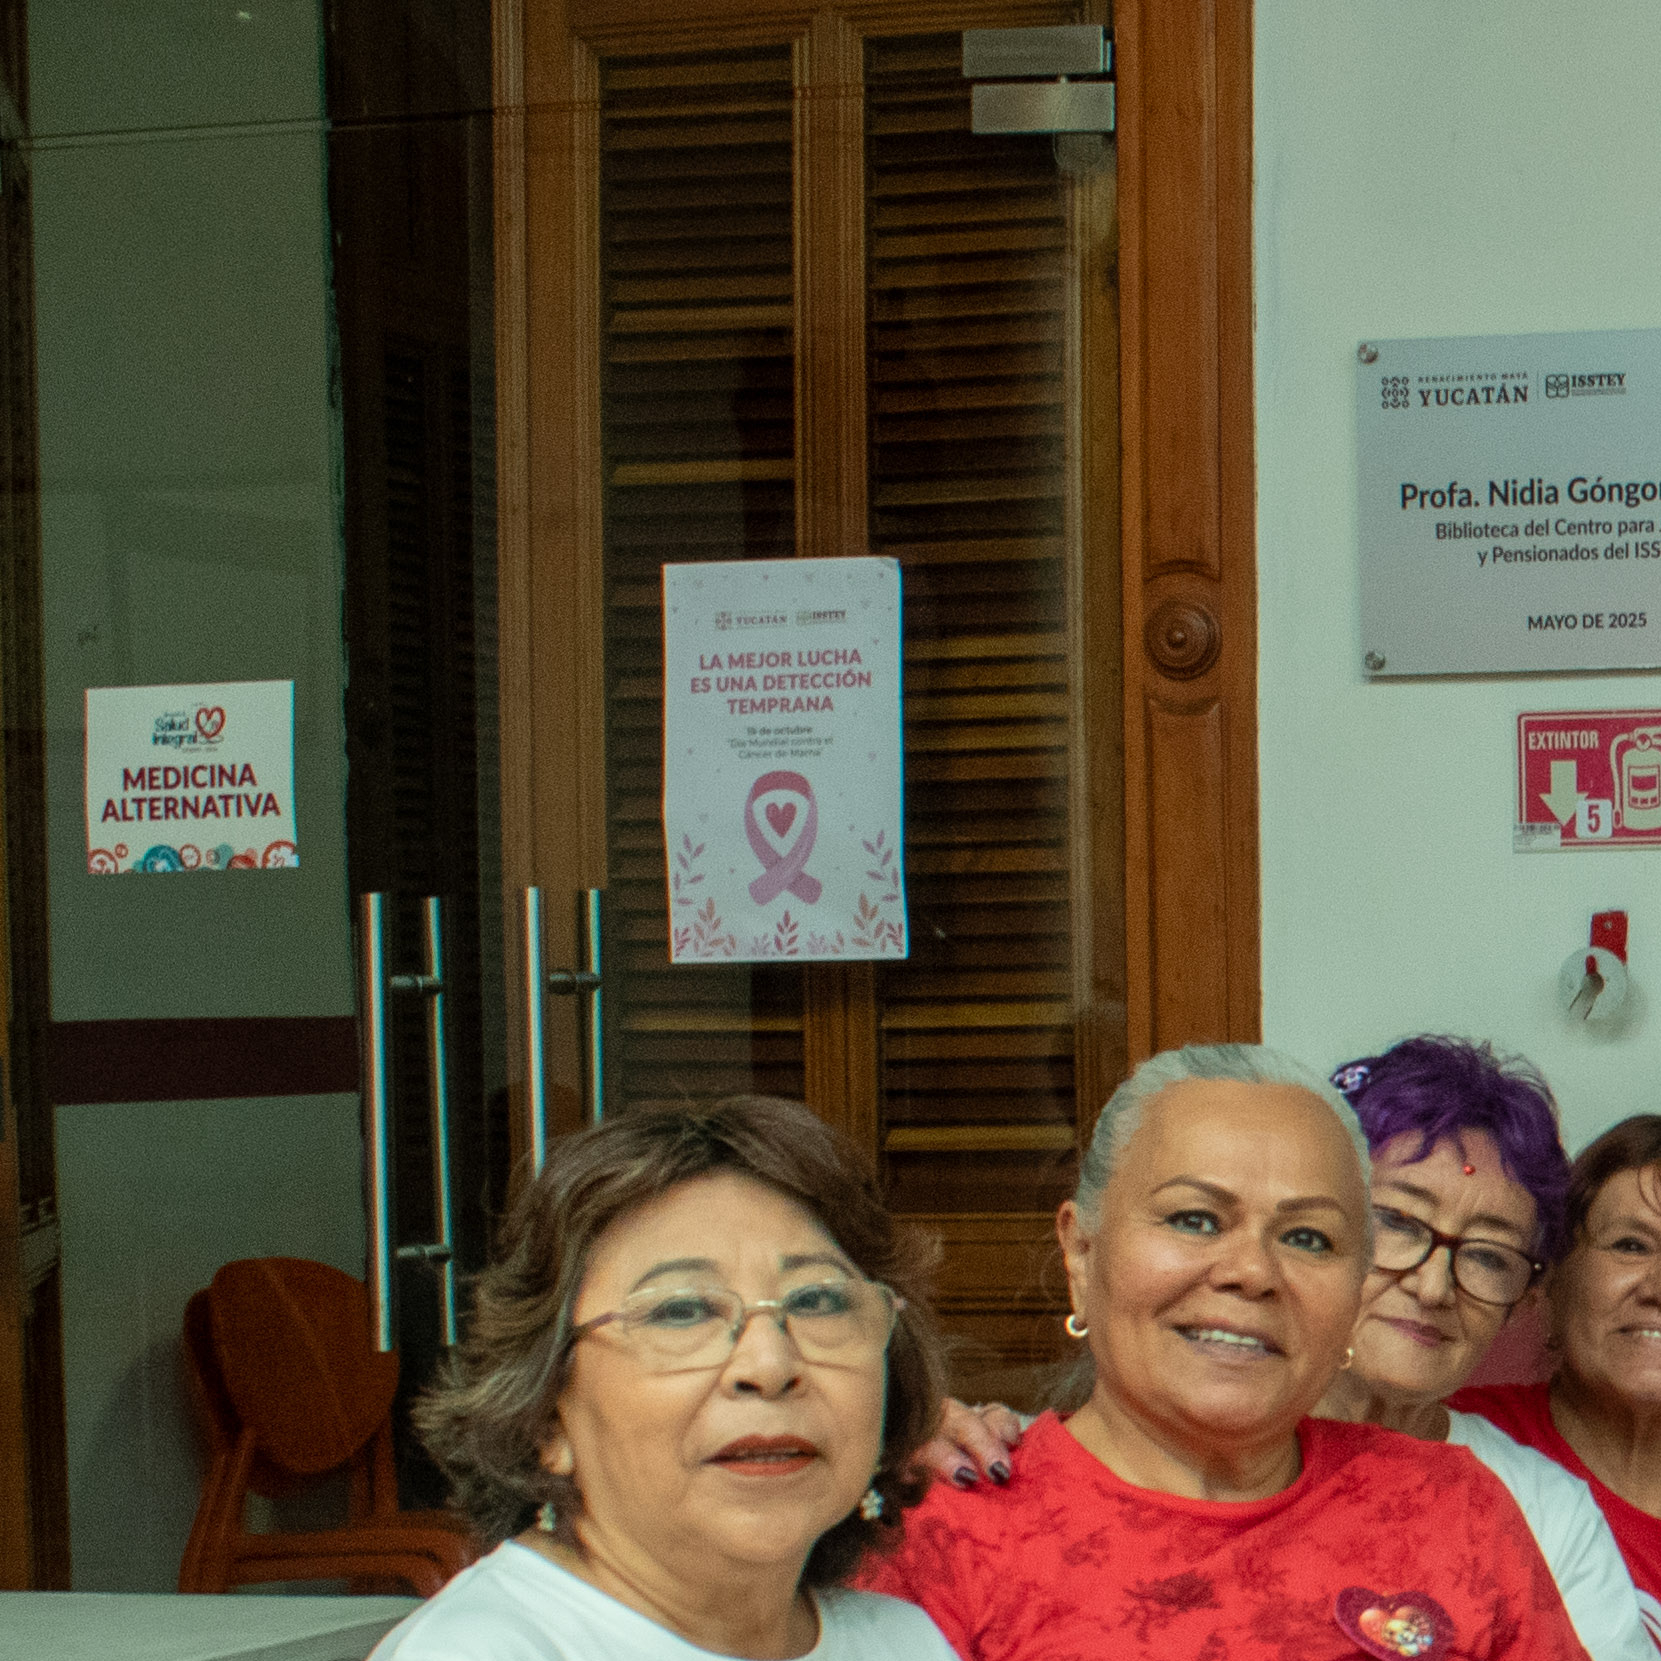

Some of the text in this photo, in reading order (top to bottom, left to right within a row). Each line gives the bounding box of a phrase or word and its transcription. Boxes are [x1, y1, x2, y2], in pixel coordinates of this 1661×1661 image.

[1571, 373, 1627, 388] ISSTEY
[1418, 382, 1529, 407] YUCATÁN
[1400, 481, 1480, 510] Profa.
[1488, 477, 1560, 507] Nidia
[1435, 518, 1520, 540] Biblioteca
[1524, 517, 1550, 538] del
[1554, 516, 1613, 537] Centro
[1617, 519, 1656, 539] para
[1477, 550, 1488, 567] y
[1492, 543, 1600, 564] Pensionados
[1603, 541, 1630, 561] del
[1527, 612, 1648, 631] MAYO DE 2025
[700, 648, 863, 671] LA MEJOR LUCHA
[690, 668, 873, 694] ES UNA DETECCIÓN
[727, 695, 835, 716] TEMPRANA
[759, 726, 772, 736] de
[1528, 730, 1599, 751] EXTINTOR
[122, 763, 257, 792] MEDICINA
[101, 792, 281, 823] ALTERNATIVA
[1587, 804, 1601, 833] 5
